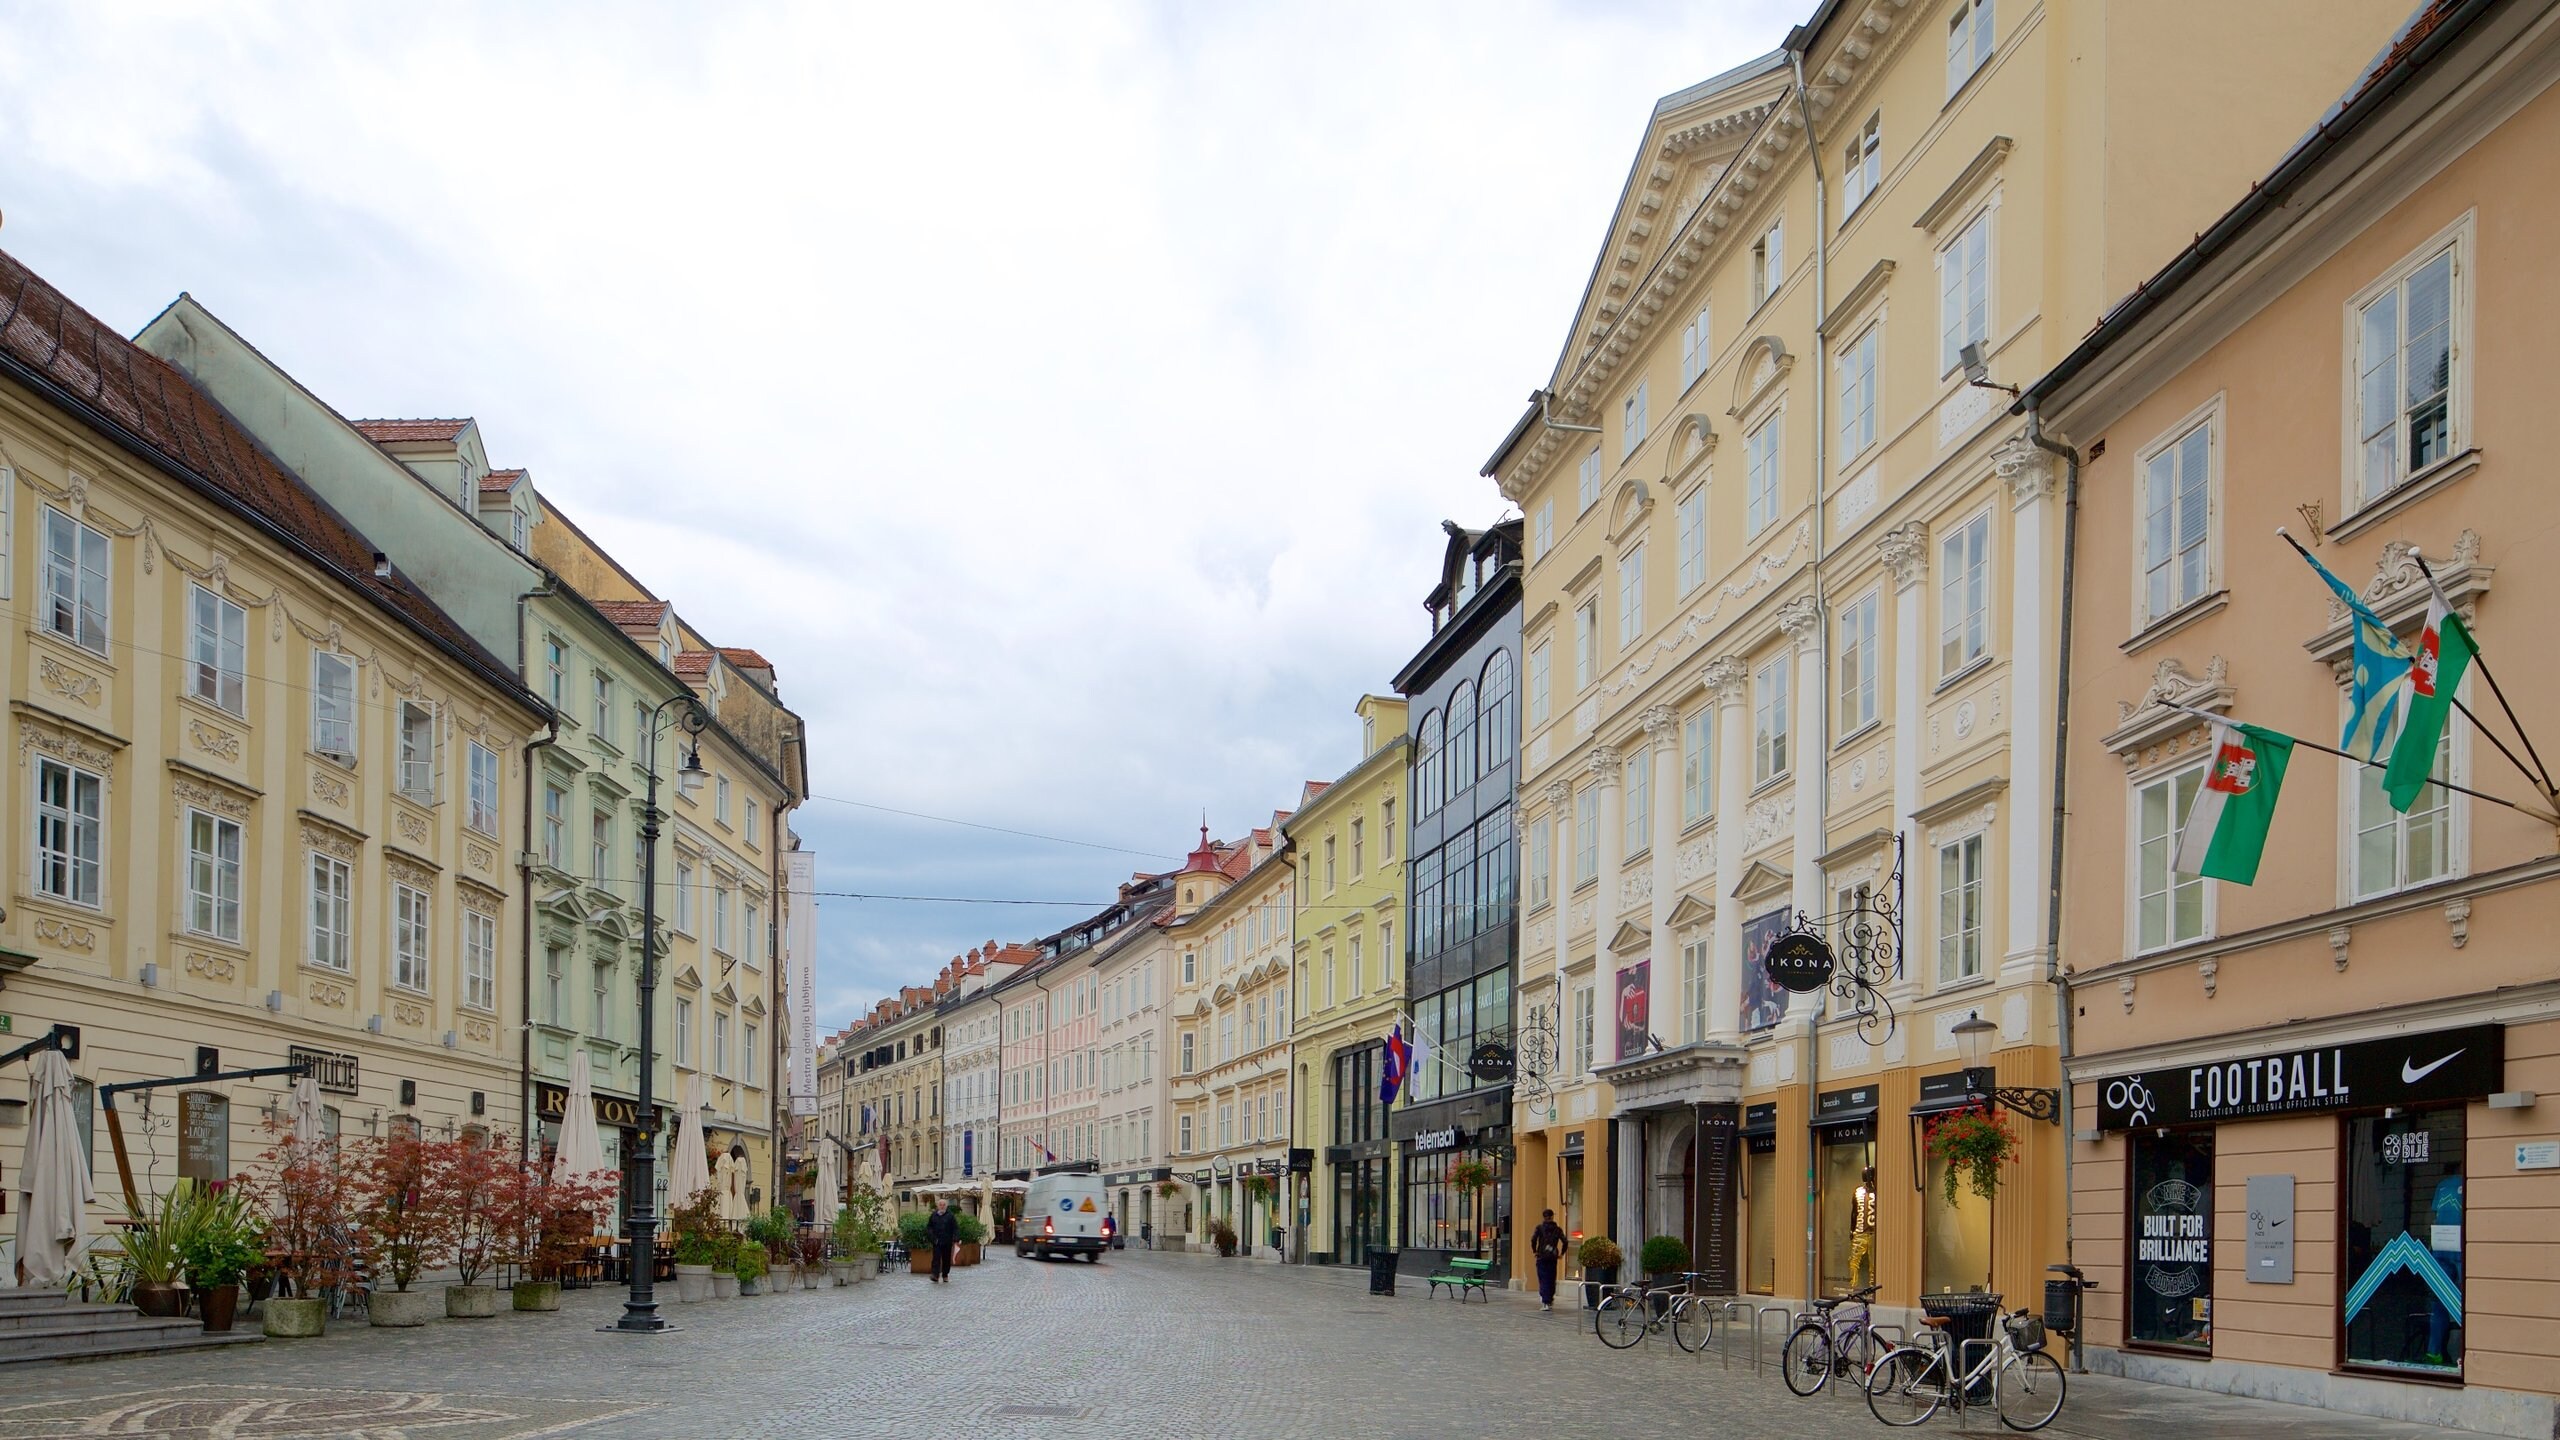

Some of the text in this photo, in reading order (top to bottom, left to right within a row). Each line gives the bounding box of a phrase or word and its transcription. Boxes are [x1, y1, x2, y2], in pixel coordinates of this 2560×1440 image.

[1770, 957, 1832, 969] IKONA
[802, 966, 813, 1094] Mestna galerija Ljubljana
[1471, 1058, 1513, 1066] IKONA
[2190, 1049, 2349, 1110] FOOTBALL
[545, 1089, 656, 1127] RTOV
[2190, 1107, 2233, 1118] ASSOCIATION
[2236, 1105, 2244, 1114] OF
[2324, 1094, 2349, 1106] STORE
[1415, 1124, 1455, 1151] telemach
[1833, 1127, 1865, 1138] IKONA
[2402, 1131, 2429, 1145] SRCE
[2402, 1144, 2429, 1158] BIJE
[2143, 1215, 2204, 1238] BUILT FOR
[2139, 1239, 2208, 1263] BRILLIANCE
